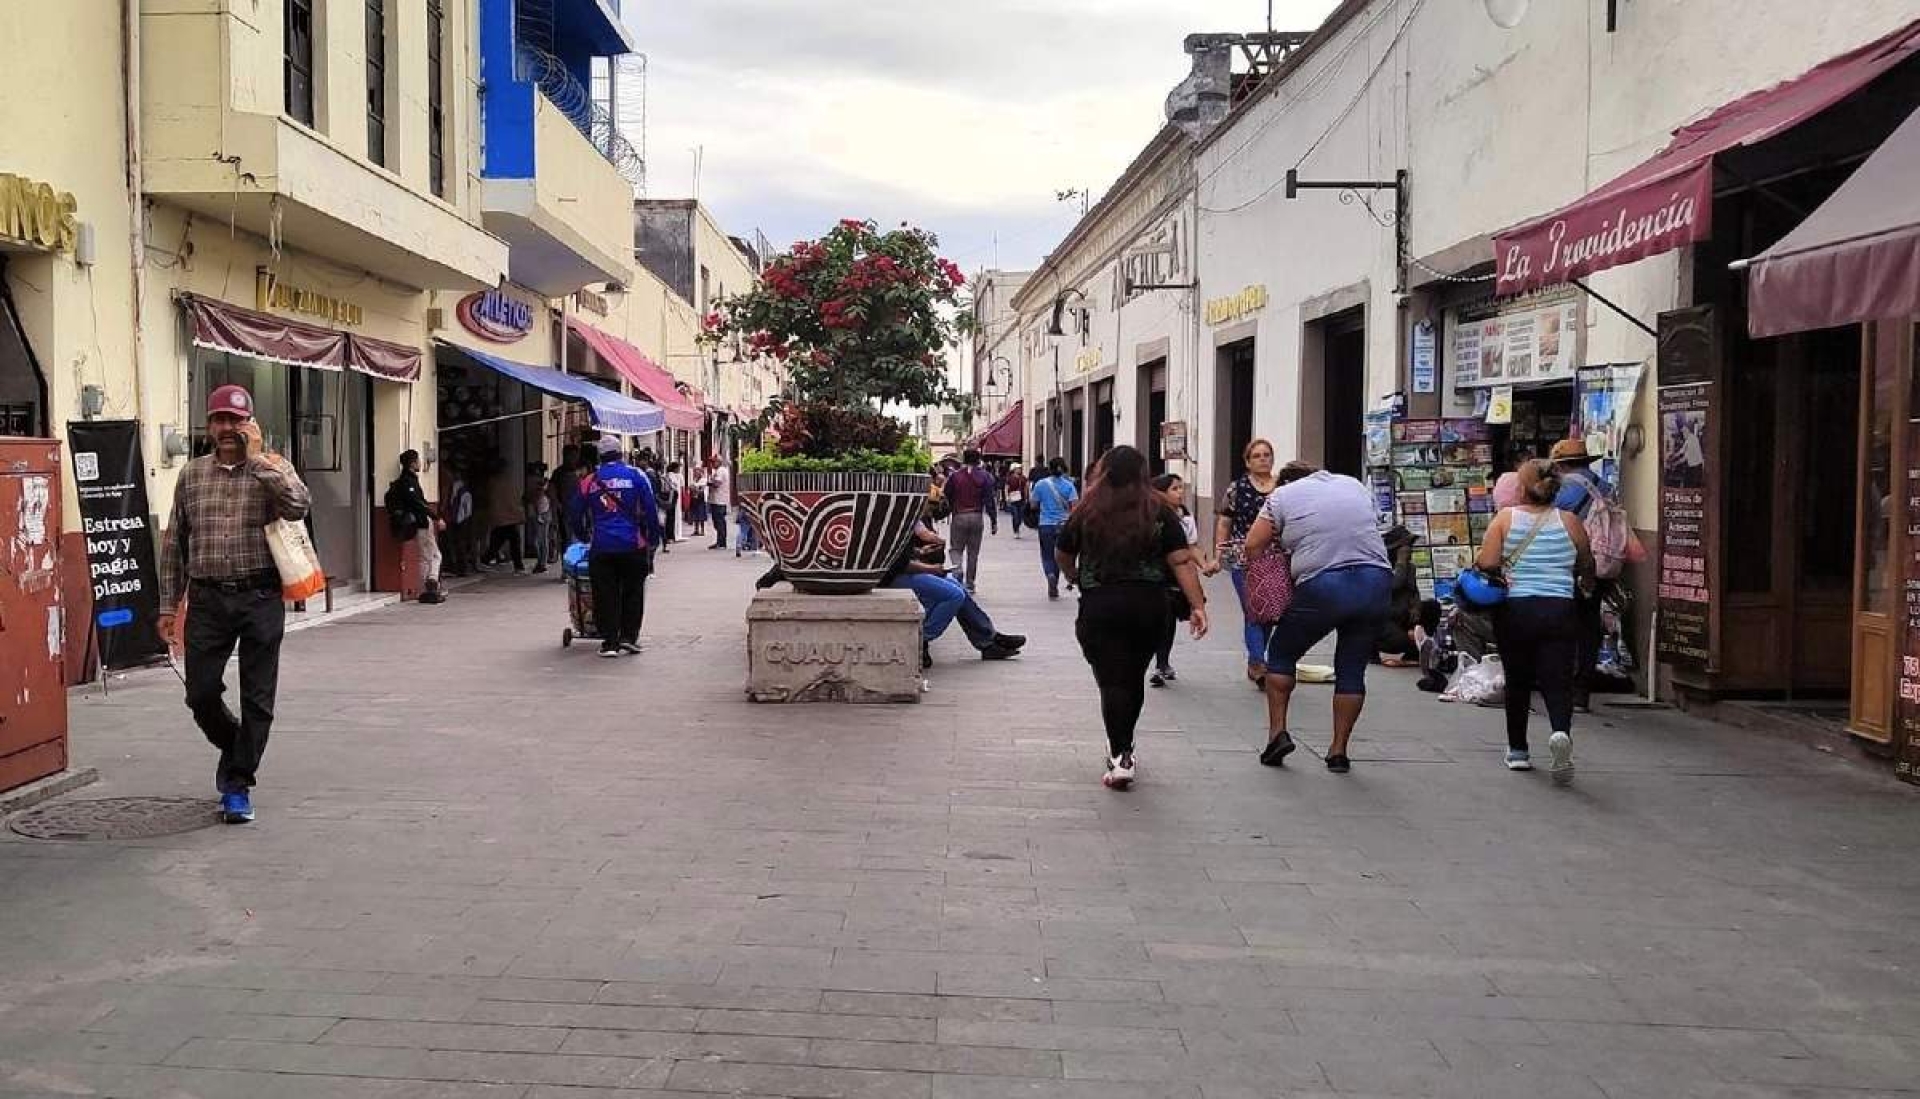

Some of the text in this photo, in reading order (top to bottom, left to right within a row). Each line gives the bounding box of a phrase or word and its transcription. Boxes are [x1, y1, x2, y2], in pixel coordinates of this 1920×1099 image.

[1500, 192, 1695, 281] La Providencia
[87, 537, 131, 554] hoy y
[94, 579, 141, 600] plazos
[765, 641, 906, 666] CUAUTLA
